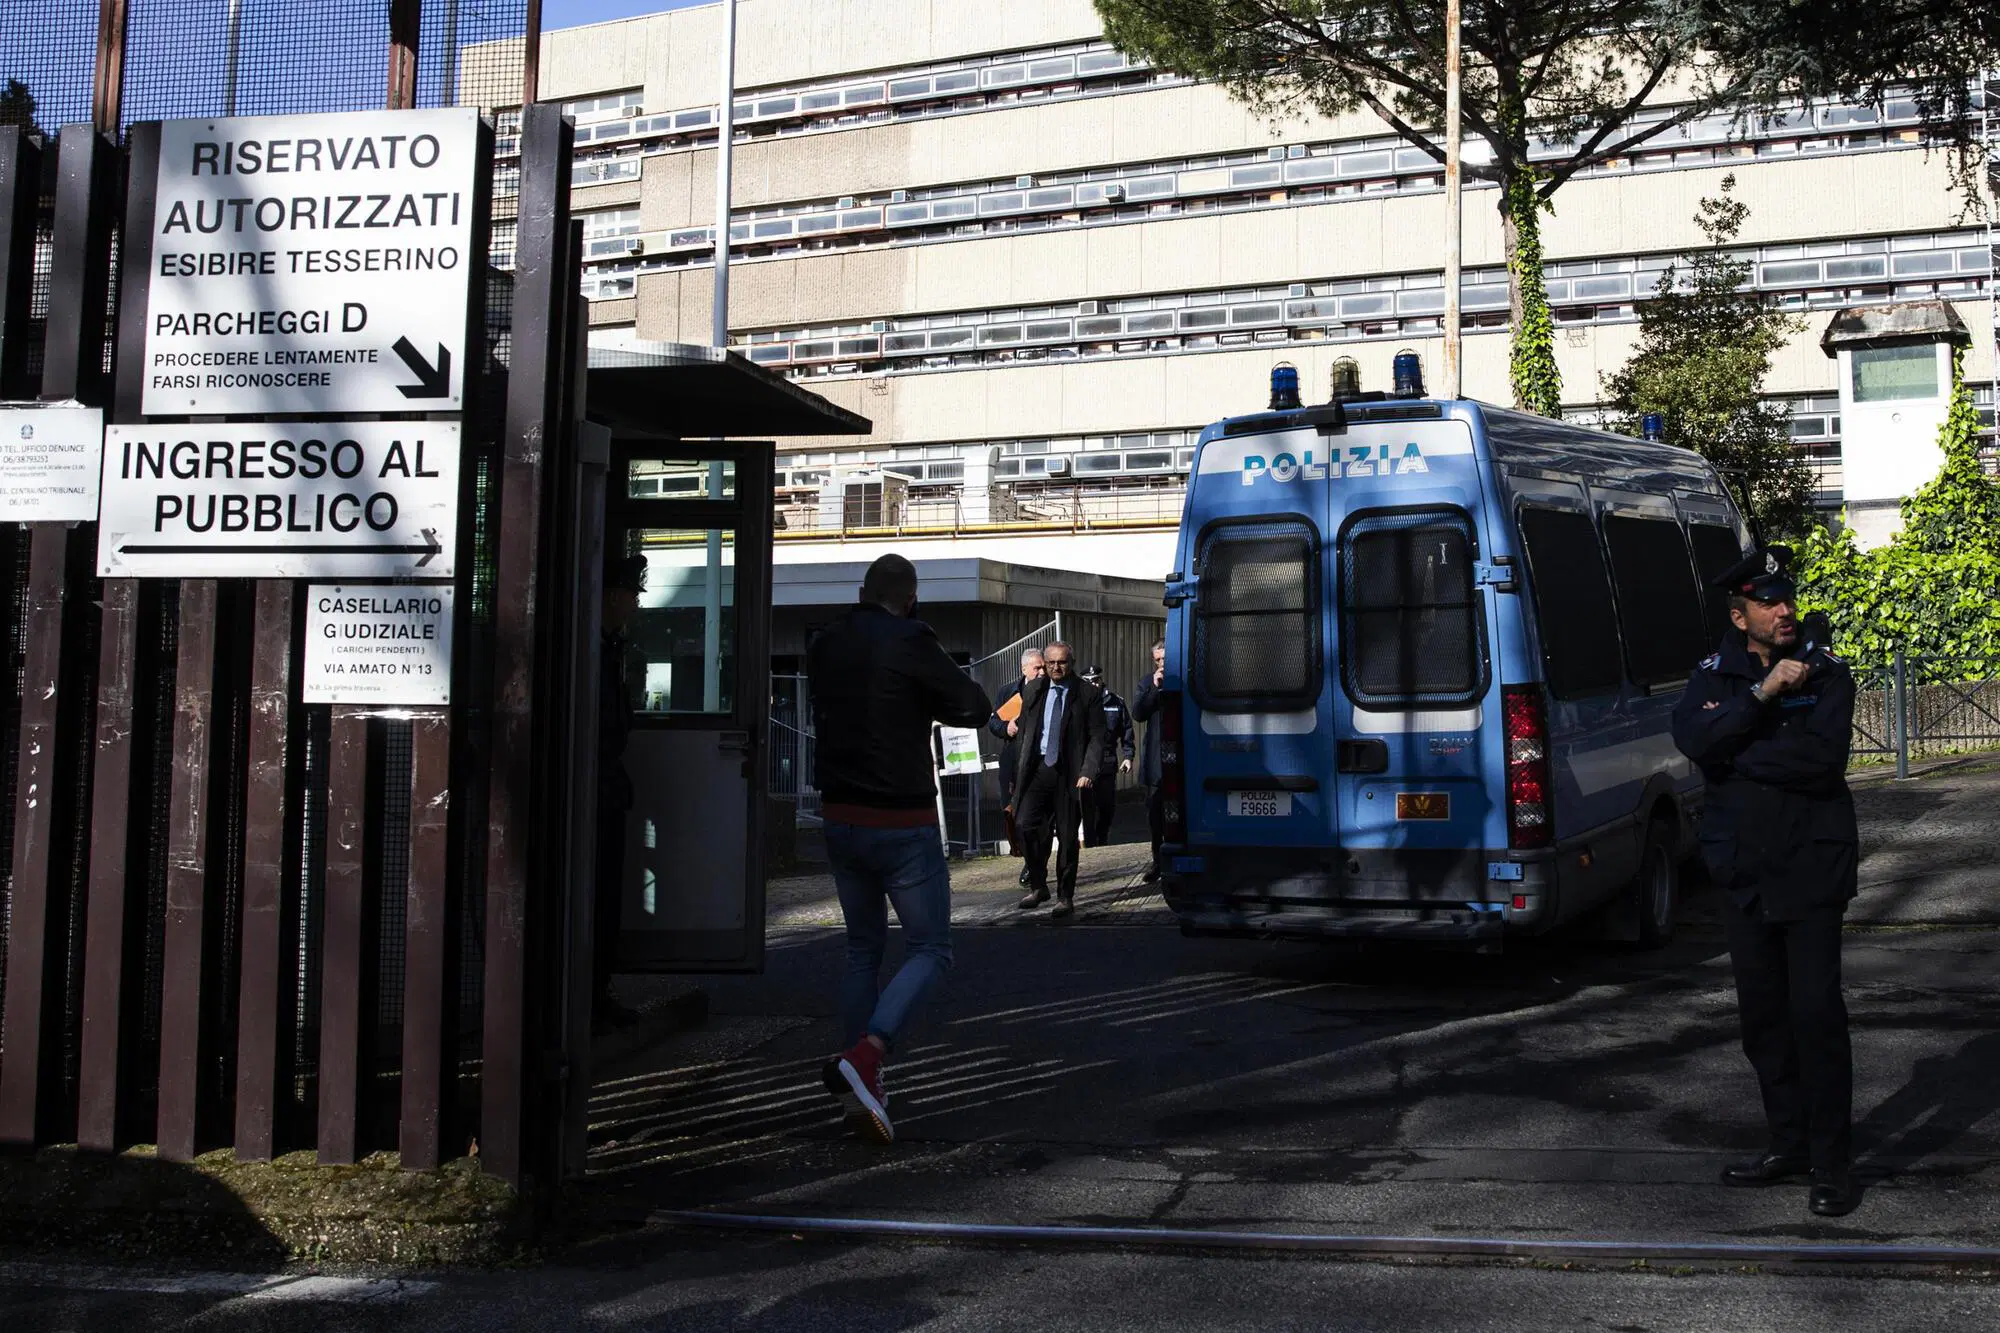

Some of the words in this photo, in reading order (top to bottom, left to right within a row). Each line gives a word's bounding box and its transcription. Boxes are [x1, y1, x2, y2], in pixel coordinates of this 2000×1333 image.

[192, 134, 440, 176] RISERVATO
[162, 192, 460, 234] AUTORIZZATI
[160, 251, 276, 277] ESIBIRE
[286, 247, 459, 273] TESSERINO
[156, 310, 329, 336] PARCHEGGI
[342, 302, 368, 333] D
[154, 351, 259, 367] PROCEDERE
[264, 349, 378, 366] LENTAMENTE
[153, 375, 200, 389] FARSI
[206, 373, 331, 388] RICONOSCERE
[49, 444, 85, 453] DENUNCE
[121, 440, 364, 479] INGRESSO
[378, 440, 440, 477] AL
[1242, 442, 1429, 486] POLIZIA
[49, 486, 86, 495] TRIBUNALE
[154, 492, 399, 532] PUBBLICO
[318, 598, 442, 614] CASELLARIO
[324, 623, 434, 640] GIUDIZIALE
[324, 664, 345, 674] VIA
[350, 664, 396, 675] AMATO
[1241, 791, 1277, 801] POLIZIA
[1241, 802, 1277, 815] F9666
